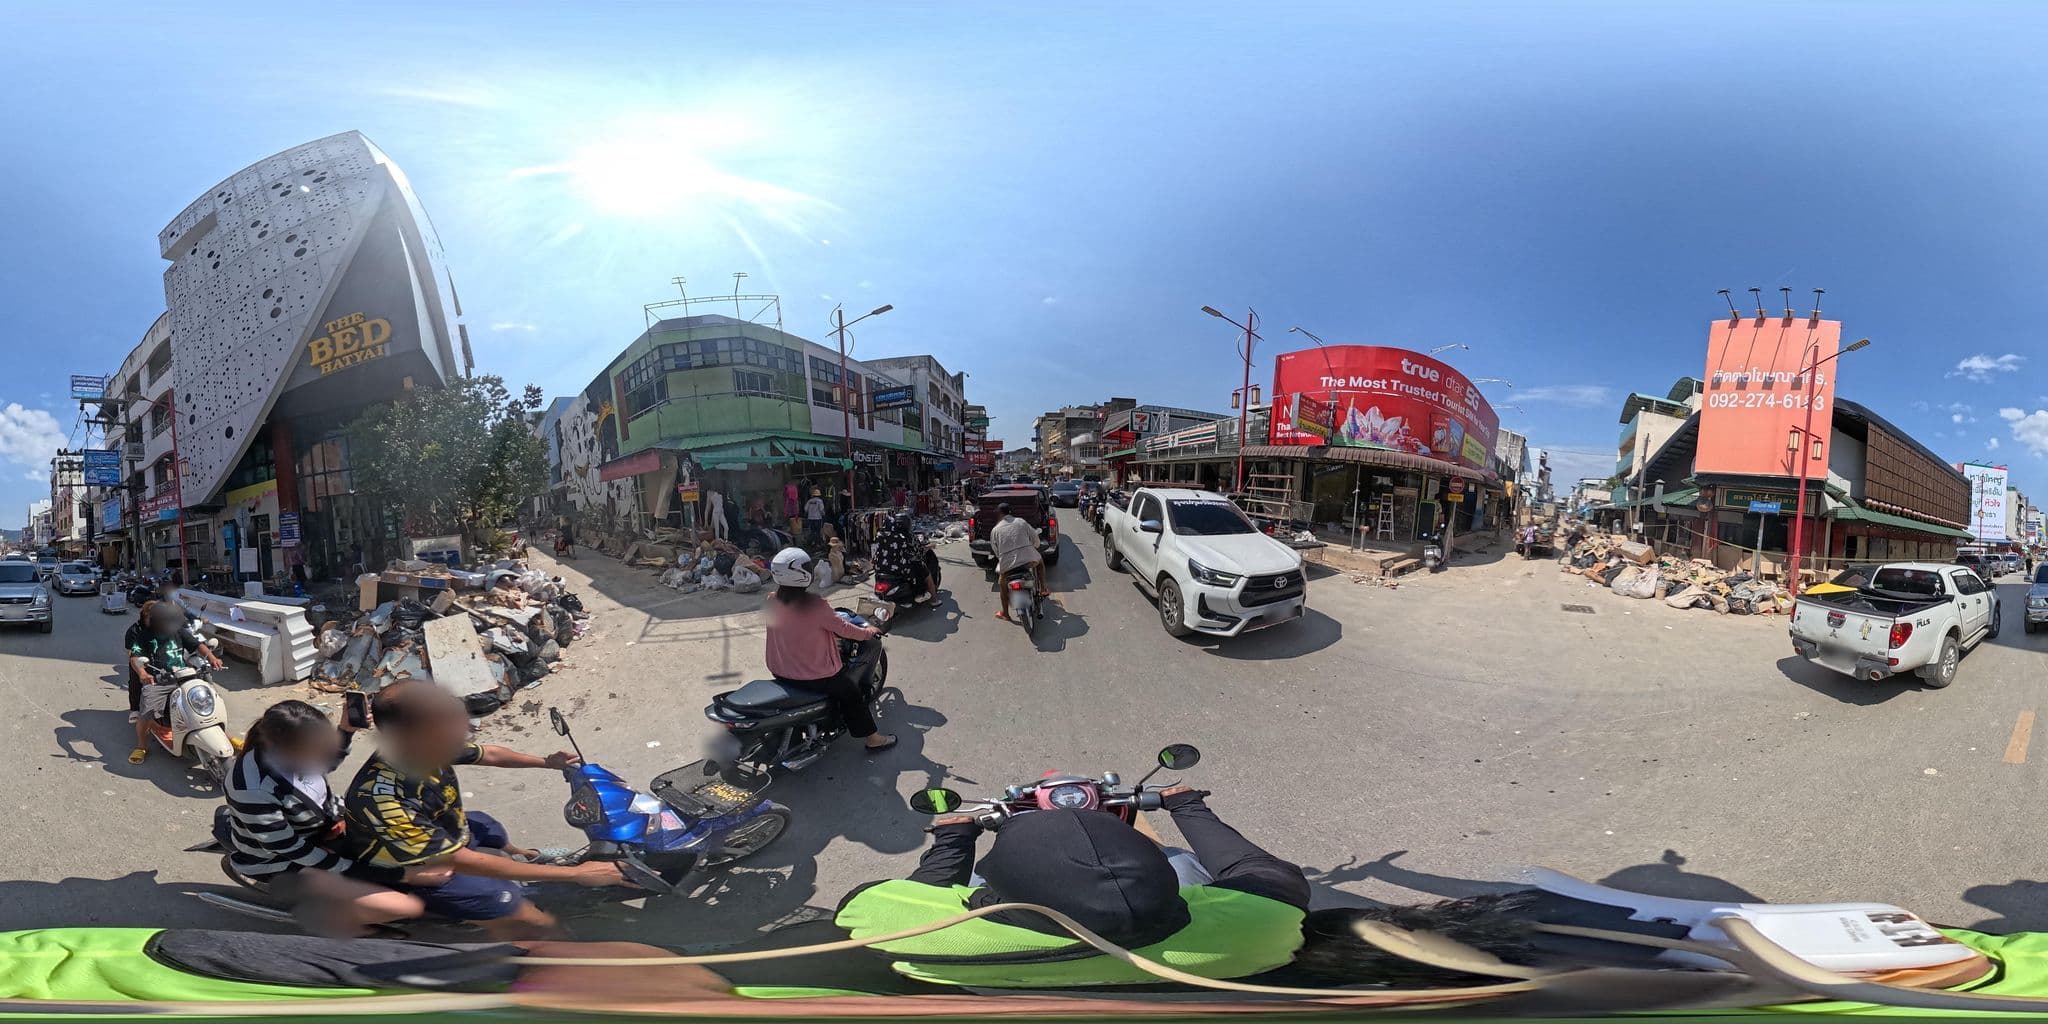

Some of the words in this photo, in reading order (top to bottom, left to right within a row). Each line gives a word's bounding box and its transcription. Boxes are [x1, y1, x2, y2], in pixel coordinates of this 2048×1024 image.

[325, 312, 366, 333] THE
[308, 318, 392, 366] BED
[320, 345, 384, 375] HATYAI
[1401, 358, 1440, 382] true
[1320, 376, 1346, 388] The
[1349, 376, 1387, 389] Most
[1390, 379, 1439, 401] Trusted
